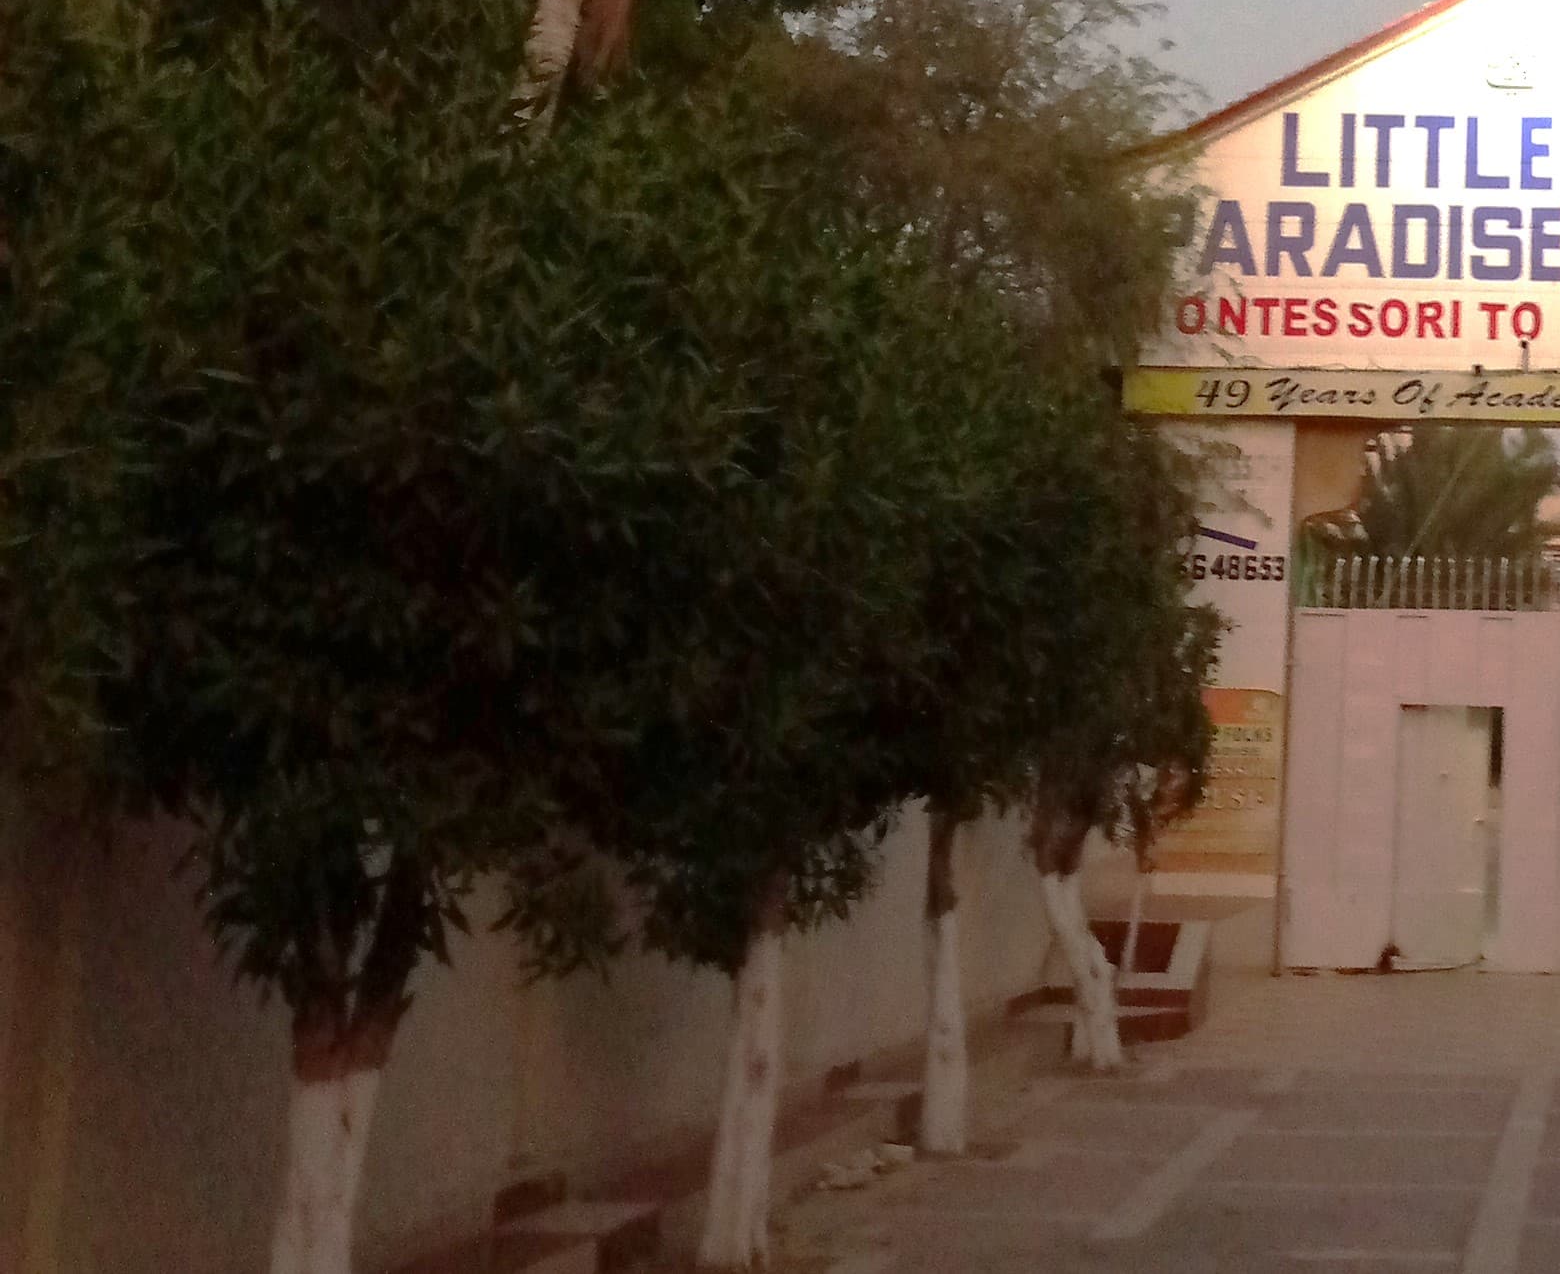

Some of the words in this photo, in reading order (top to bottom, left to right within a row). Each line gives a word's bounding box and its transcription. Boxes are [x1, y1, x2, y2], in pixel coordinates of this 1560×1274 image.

[1280, 111, 1553, 190] LITTLE
[1478, 300, 1543, 341] TO
[1195, 378, 1252, 409] 49
[1264, 376, 1378, 411] Years
[1391, 379, 1443, 414] Of
